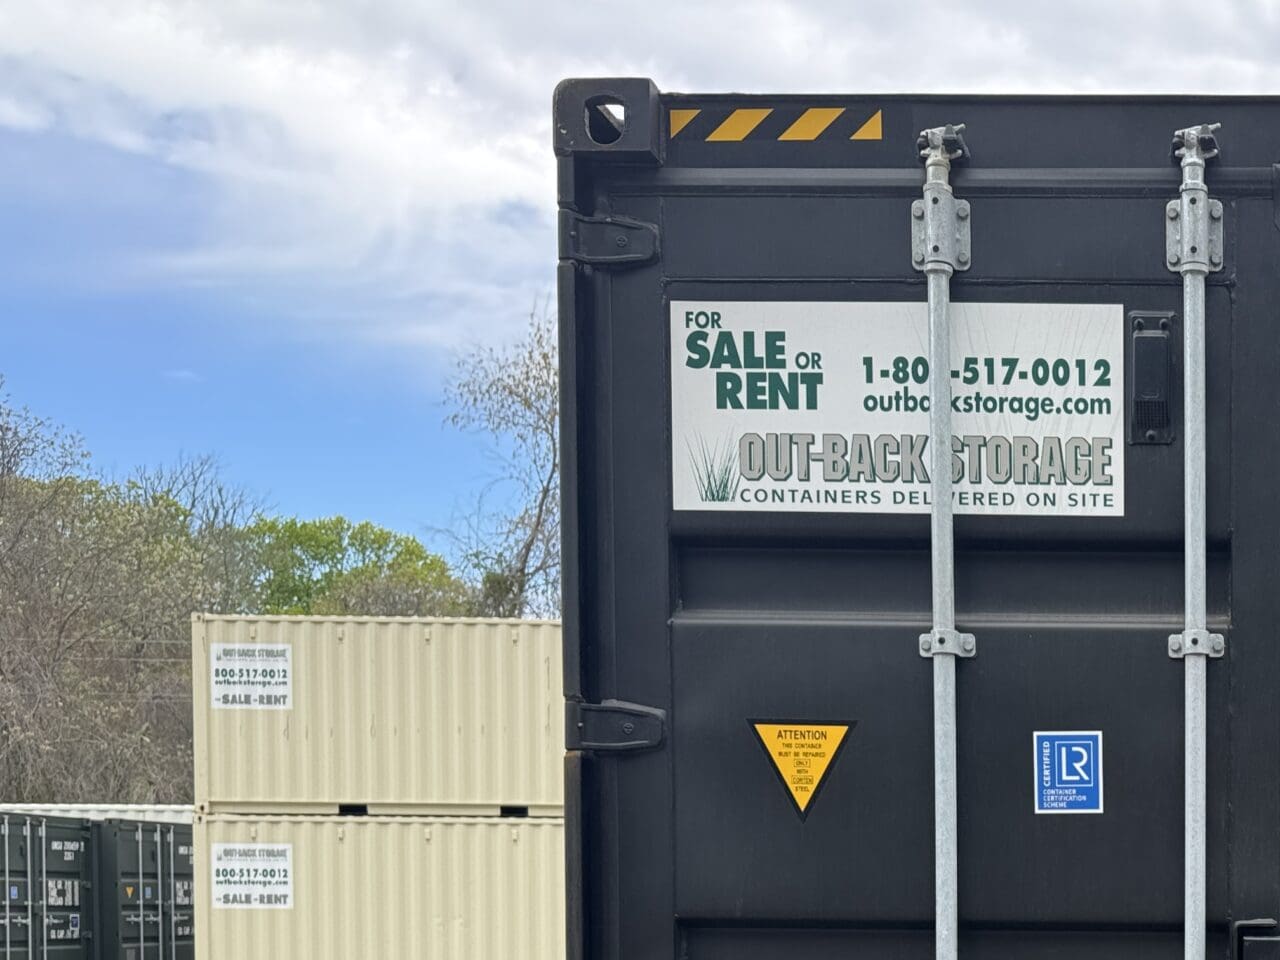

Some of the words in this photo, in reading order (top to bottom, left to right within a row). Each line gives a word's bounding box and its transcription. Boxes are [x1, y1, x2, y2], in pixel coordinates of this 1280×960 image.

[685, 311, 722, 329] FOR
[685, 330, 787, 369] SALE
[795, 352, 822, 369] OR
[862, 355, 1112, 387] 1-80-517-0012
[715, 372, 823, 410] RENT
[863, 386, 1112, 421] outbakstorage.com
[739, 432, 931, 483] OUT-BACK
[740, 488, 882, 505] CONTAINERS
[893, 490, 1016, 507] DELERED
[1026, 491, 1057, 507] ON
[1068, 491, 1115, 508] SITE
[777, 729, 827, 740] ATTENTION
